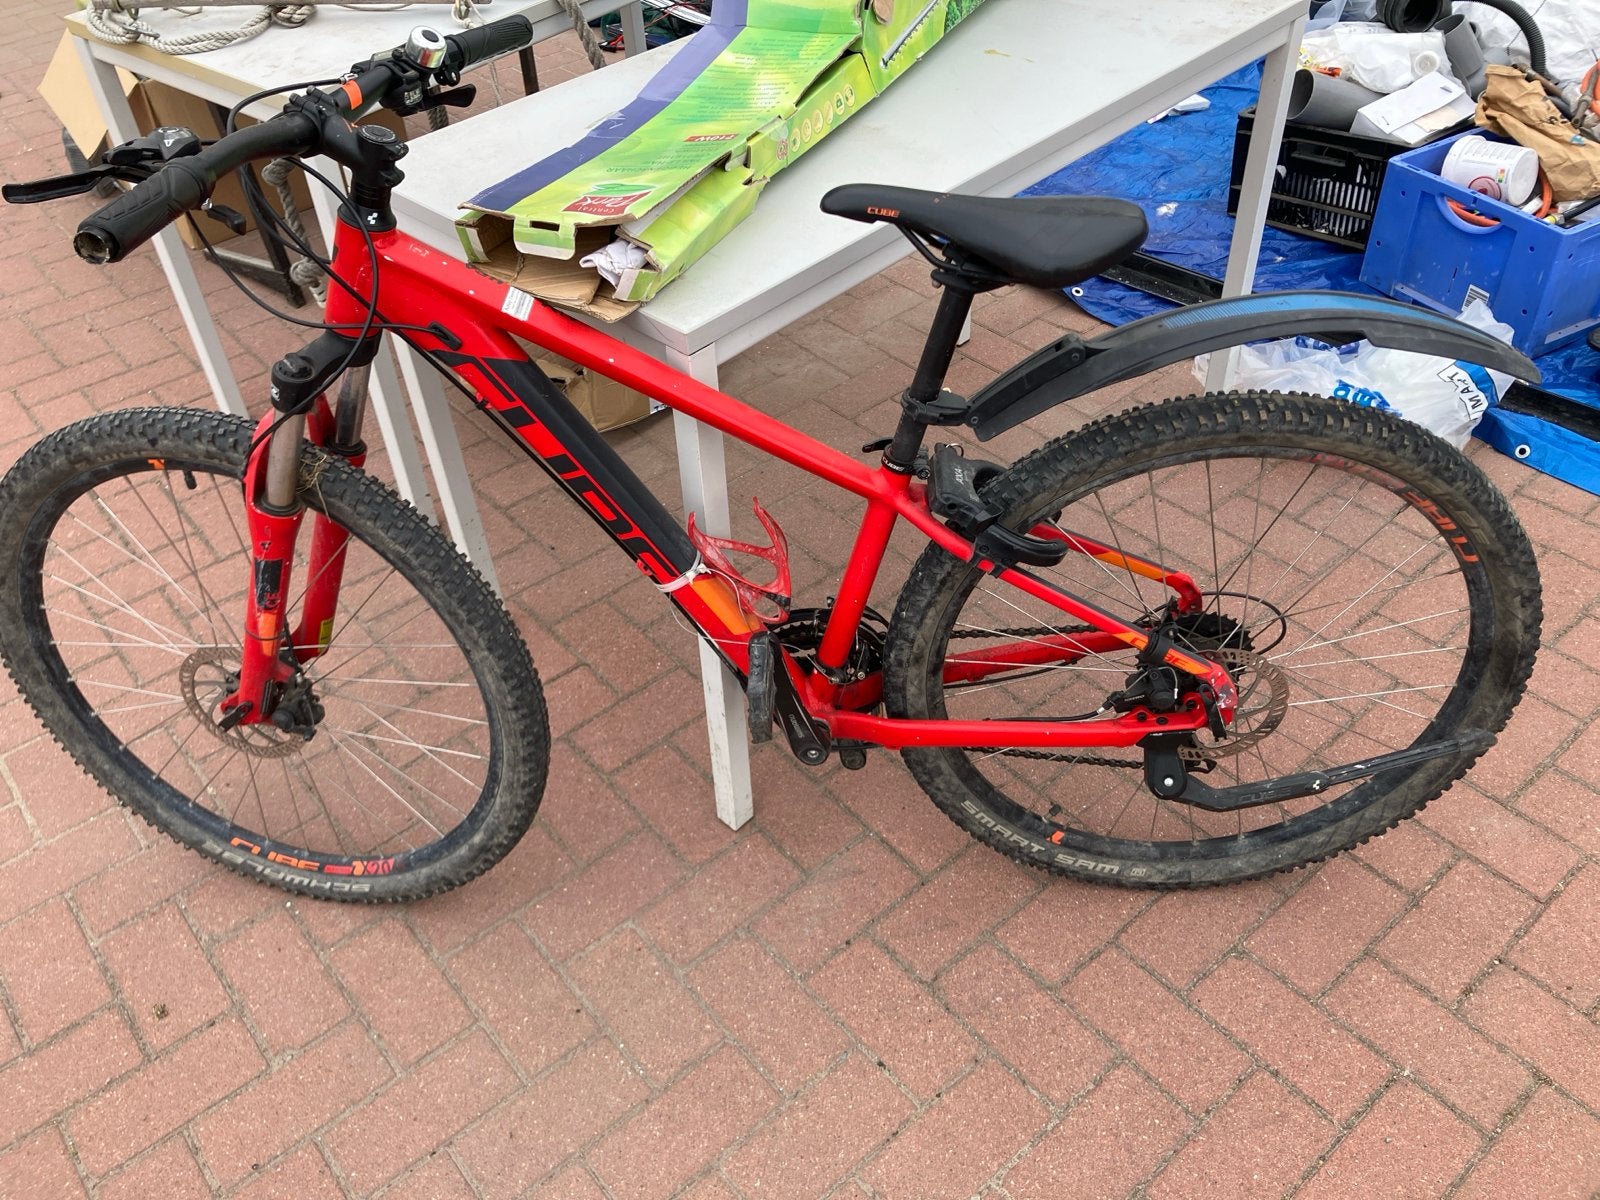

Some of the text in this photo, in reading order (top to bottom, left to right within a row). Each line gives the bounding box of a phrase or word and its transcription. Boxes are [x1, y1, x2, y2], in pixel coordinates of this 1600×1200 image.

[577, 205, 615, 214] Central
[866, 206, 900, 218] CUBE
[882, 456, 905, 472] CUBE
[960, 800, 1120, 874] SMART SAM
[202, 840, 372, 893] SCHWALBE
